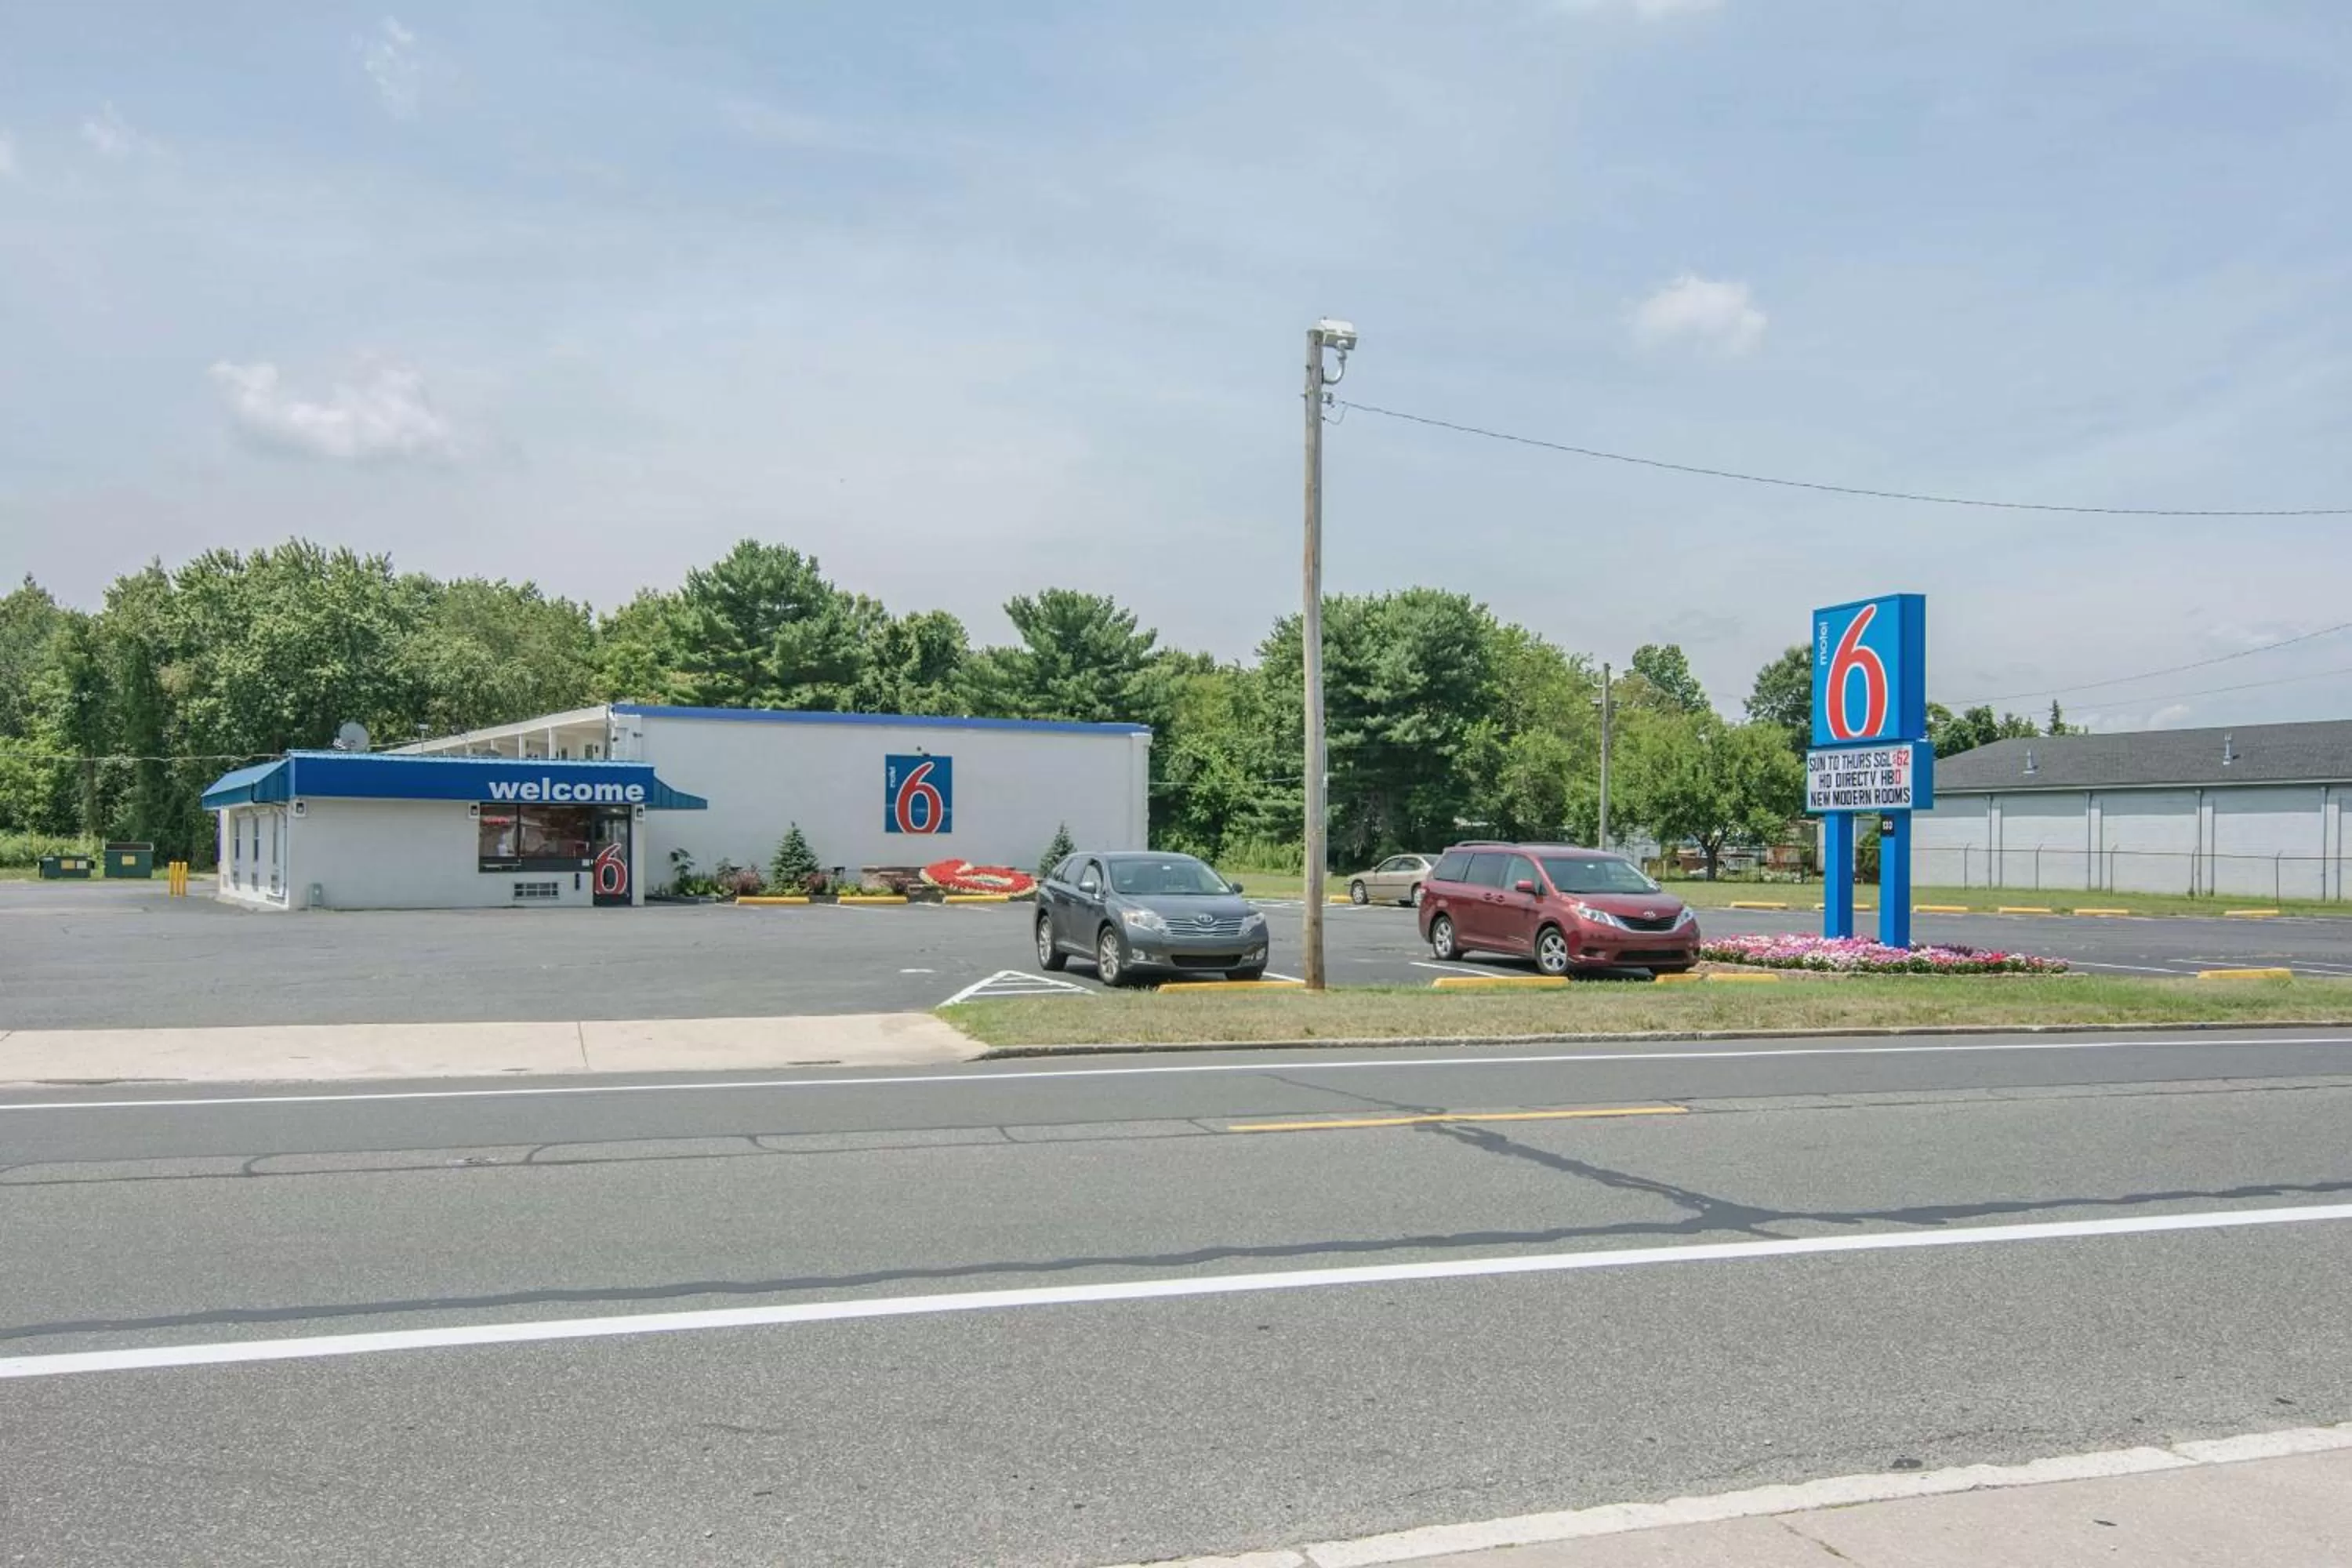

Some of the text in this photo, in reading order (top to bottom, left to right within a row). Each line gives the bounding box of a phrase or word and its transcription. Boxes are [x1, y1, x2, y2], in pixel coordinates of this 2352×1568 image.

[1819, 603, 1889, 740] motel 6
[1809, 757, 1826, 772] SUN
[1828, 756, 1839, 771] TO
[1842, 753, 1871, 769] THURS
[1874, 752, 1892, 768] SGL
[488, 777, 645, 801] welcome
[1819, 773, 1832, 789] HD
[1882, 769, 1901, 786] HBO
[895, 761, 943, 834] 6
[1810, 787, 1911, 807] NEW MODERN ROOMS
[593, 843, 628, 895] 6
